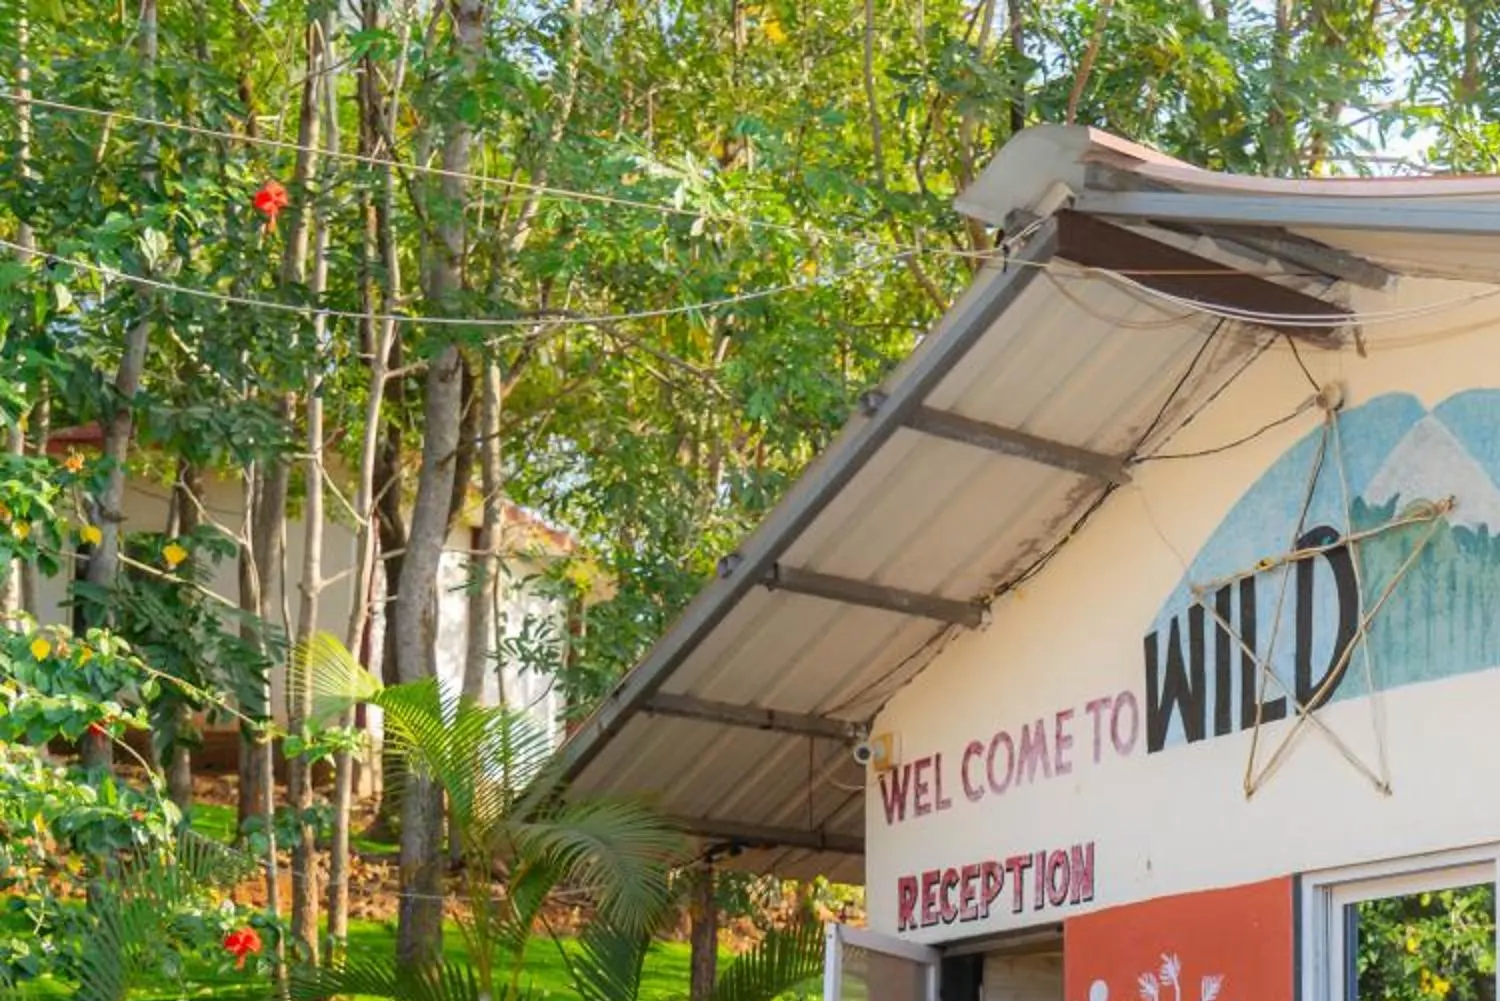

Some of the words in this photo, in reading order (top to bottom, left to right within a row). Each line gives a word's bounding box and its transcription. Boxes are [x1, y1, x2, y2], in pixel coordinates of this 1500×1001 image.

[1085, 690, 1139, 764] TO
[1143, 525, 1360, 754] WILD
[897, 841, 1096, 932] RECEPTION
